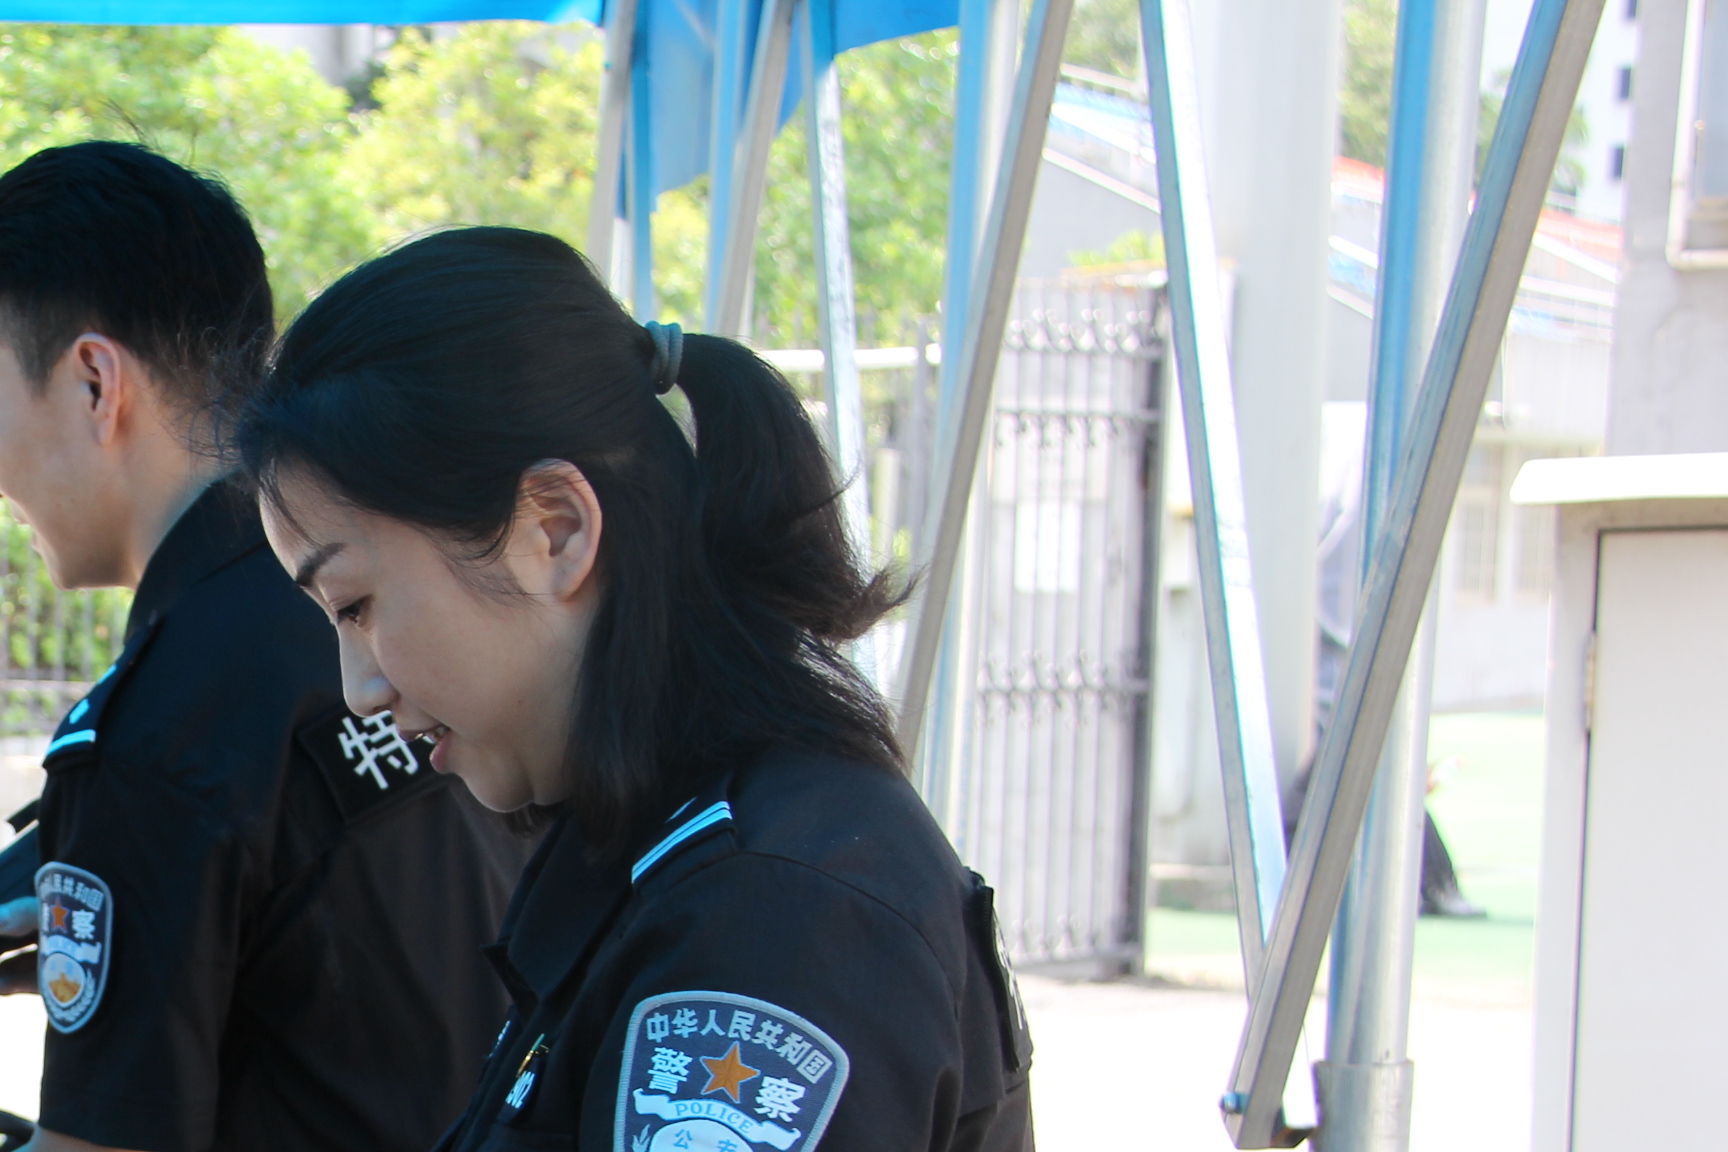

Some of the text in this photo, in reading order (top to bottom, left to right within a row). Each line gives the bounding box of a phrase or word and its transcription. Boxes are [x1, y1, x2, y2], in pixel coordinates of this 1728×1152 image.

[338, 710, 435, 790] 特
[645, 1007, 833, 1084] 中华人民共和国
[647, 1046, 807, 1123] 警察
[674, 1101, 754, 1135] POLICE
